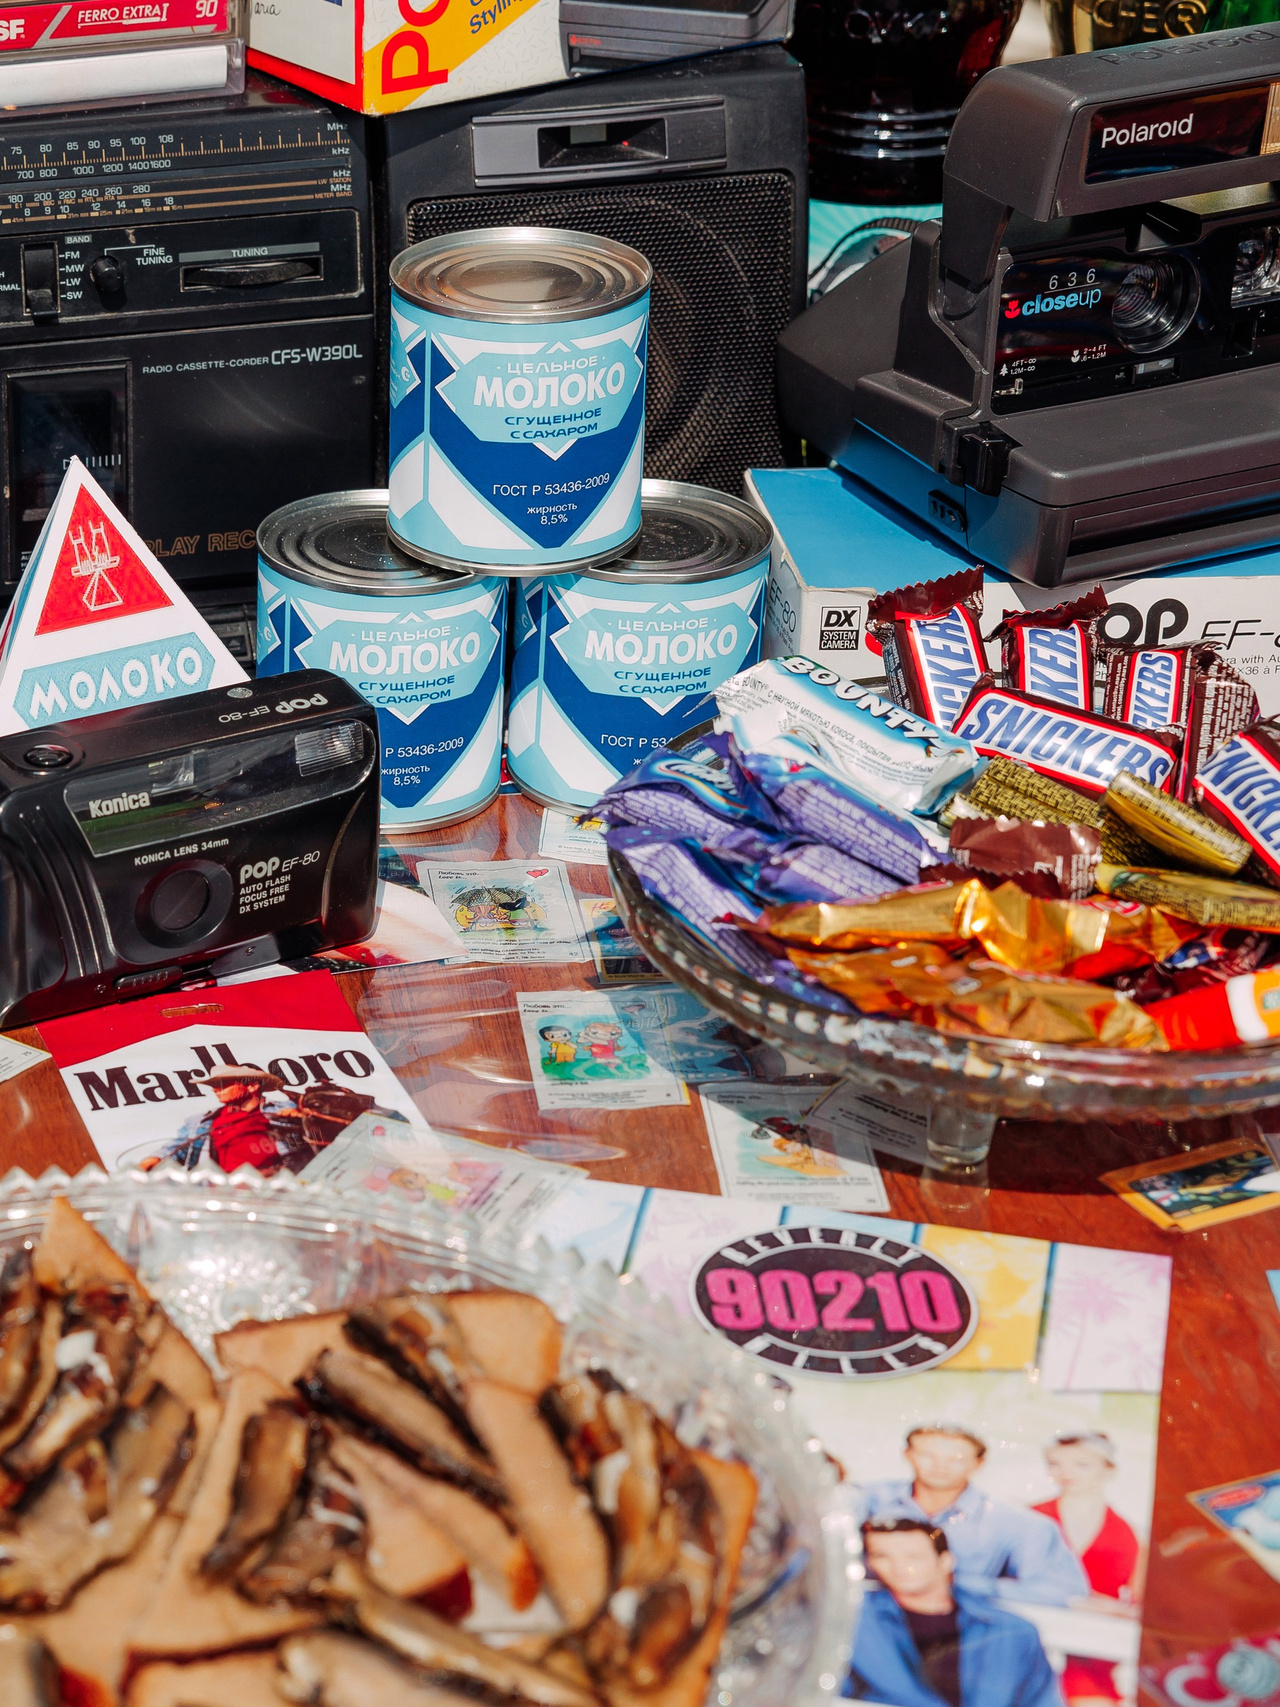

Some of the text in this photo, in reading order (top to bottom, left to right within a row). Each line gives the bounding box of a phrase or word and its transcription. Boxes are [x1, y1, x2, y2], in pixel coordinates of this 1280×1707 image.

[77, 8, 119, 24] FERRO
[195, 0, 218, 18] 90
[130, 122, 348, 146] 100 108 MHz
[1101, 113, 1194, 149] Polaroid
[72, 165, 95, 176] 1000
[150, 159, 171, 169] 1600
[132, 184, 151, 194] 280
[330, 183, 352, 193] MHz
[66, 236, 90, 245] BAND
[65, 251, 80, 260] FM
[136, 255, 173, 266] TUNING
[143, 247, 165, 257] FINE
[231, 247, 269, 258] TUNING
[65, 264, 84, 273] MW
[66, 278, 81, 286] LW
[66, 291, 83, 300] SW
[1021, 287, 1102, 318] closeup
[142, 344, 363, 375] RADIO CASSETTE-CORDER CFS-W390L
[507, 355, 598, 375] ЦЕЛЬНОЕ
[473, 361, 626, 409] МОЛОКО
[504, 407, 602, 427] СГУЩЕННОЕ
[522, 422, 598, 440] САХАРОМ
[493, 472, 611, 497] ГОСТ Р 53436-2009
[527, 502, 578, 515] жирность
[208, 530, 257, 553] REC
[617, 617, 709, 633] ЦЕЛЬНОЕ
[823, 609, 858, 628] DX
[1096, 598, 1189, 646] OP
[361, 625, 451, 643] ЦЕЛЬНОЕ
[822, 631, 857, 641] SYSTEM
[328, 631, 481, 676] МОЛОКО
[583, 624, 739, 666] МОЛОКО
[821, 640, 857, 650] CAMERA
[1241, 654, 1264, 665] with
[29, 646, 203, 721] МОЛОКО
[358, 674, 456, 692] СГУЩЕННОЕ
[614, 666, 712, 683] СГУЩЕННОЕ
[375, 688, 451, 705] САХАРОМ
[631, 681, 707, 694] САХАРОМ
[780, 656, 940, 740] BOUNTY
[218, 693, 329, 723] POP EF-80
[385, 736, 465, 759] Р 53436-2009
[600, 734, 635, 749] ГОСТ
[639, 737, 648, 749] Р
[960, 698, 1171, 789] SNICKERS
[380, 764, 431, 777] жирность
[88, 791, 151, 819] Konica
[134, 837, 230, 867] KONICA LENS 34mm
[239, 851, 320, 884] POP EF-80
[239, 873, 291, 895] AUTO FLASH
[239, 883, 290, 905] FOCUS FREE
[239, 894, 286, 914] DX SYSTEM
[719, 1227, 922, 1268] BEVERLY
[705, 1267, 964, 1333] 90210
